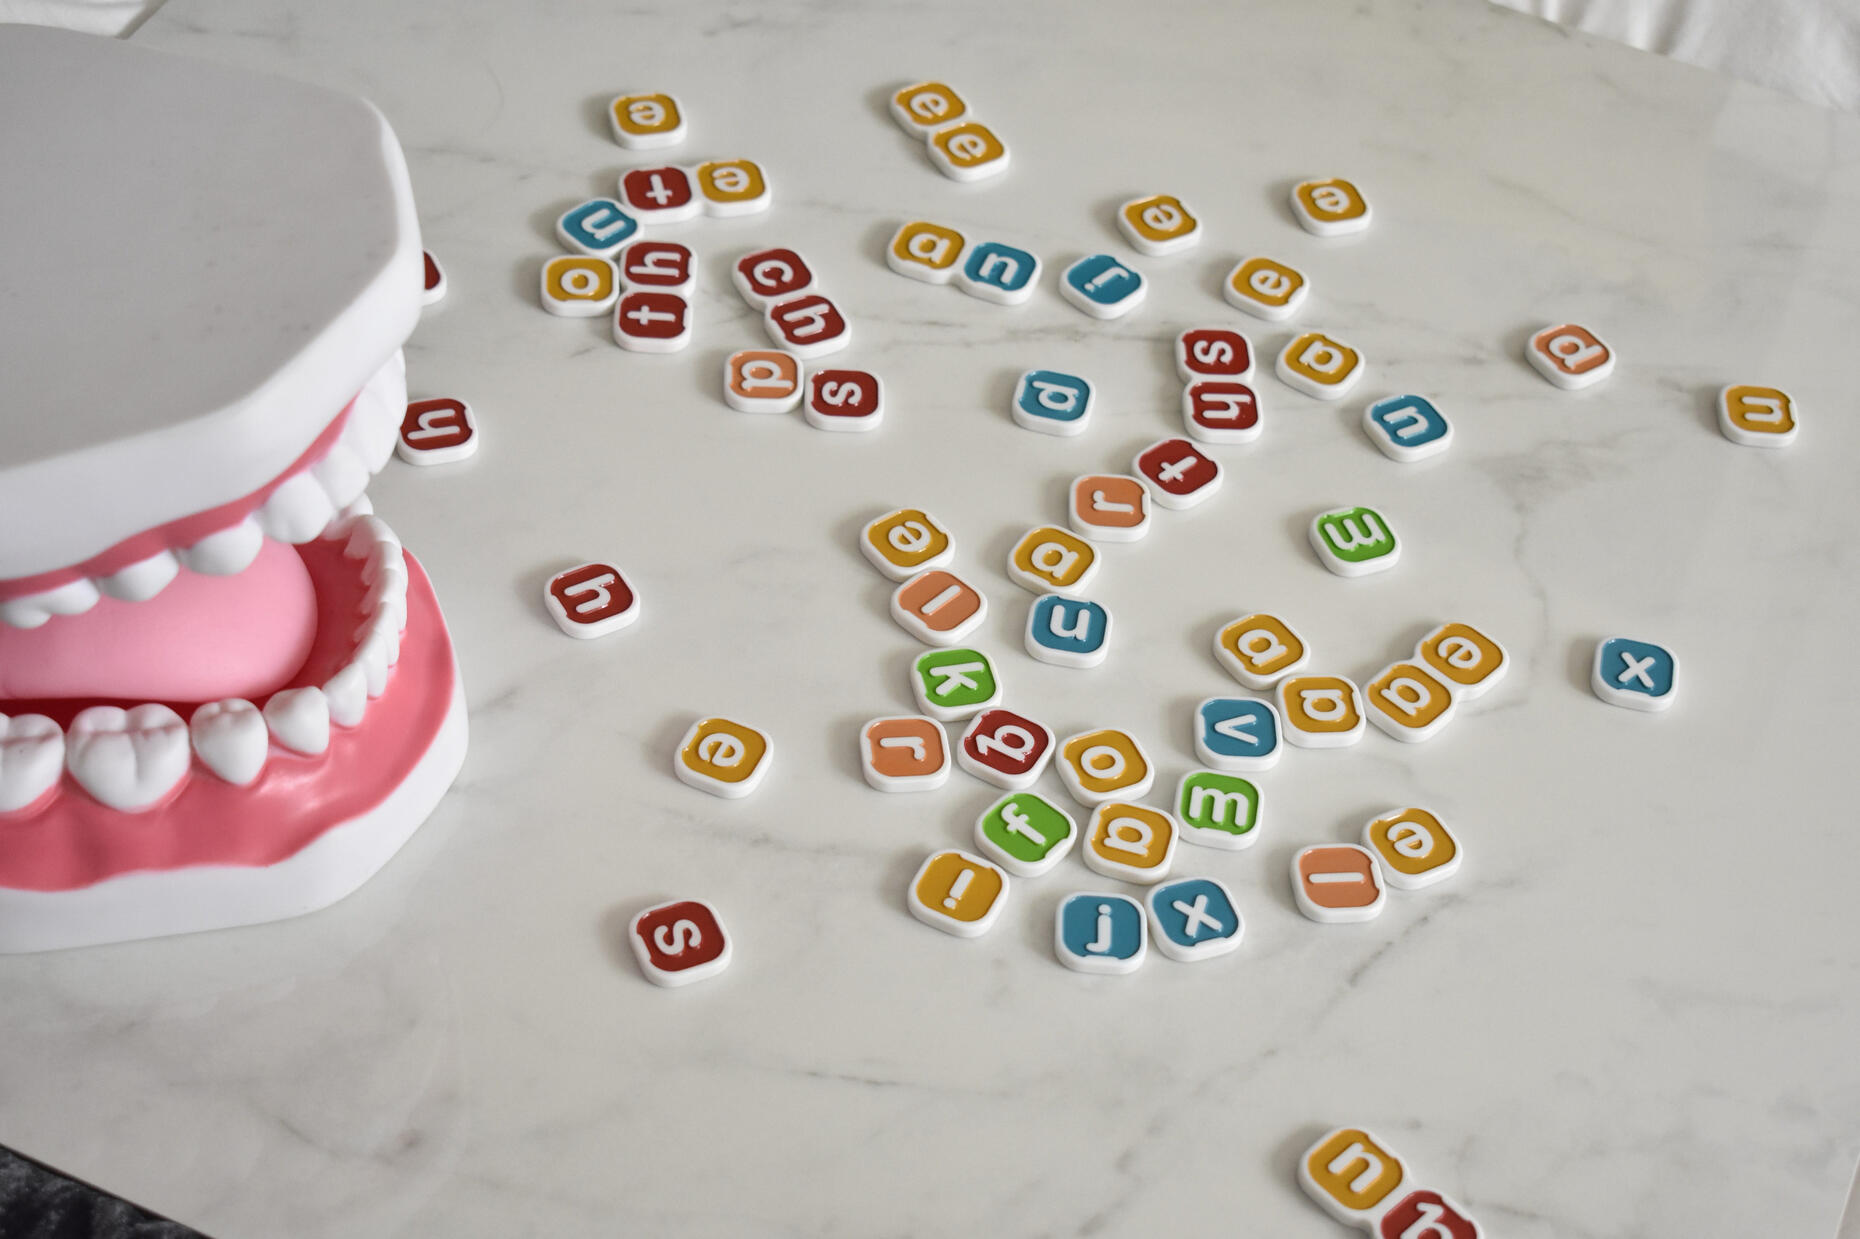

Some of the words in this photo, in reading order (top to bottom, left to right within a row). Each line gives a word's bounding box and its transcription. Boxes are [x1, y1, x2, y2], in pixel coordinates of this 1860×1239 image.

[629, 101, 664, 124] e
[1312, 187, 1348, 211] e
[1143, 205, 1181, 229] e
[561, 269, 598, 294] o
[1250, 270, 1290, 296] e
[822, 381, 862, 406] s
[408, 409, 460, 439] h
[1159, 456, 1197, 480] t
[1093, 491, 1134, 512] r
[889, 521, 930, 552] e
[1032, 543, 1078, 577] a
[564, 573, 614, 613] h
[930, 662, 984, 695] k
[1618, 652, 1655, 688] x
[1215, 714, 1258, 745] v
[699, 733, 744, 766] e
[880, 736, 925, 760] r
[1081, 746, 1124, 778] o
[1189, 786, 1248, 826] m
[1002, 803, 1046, 844] f
[1388, 822, 1433, 858] e
[1086, 904, 1112, 953] j
[1173, 894, 1222, 938] x
[654, 920, 701, 955] s
